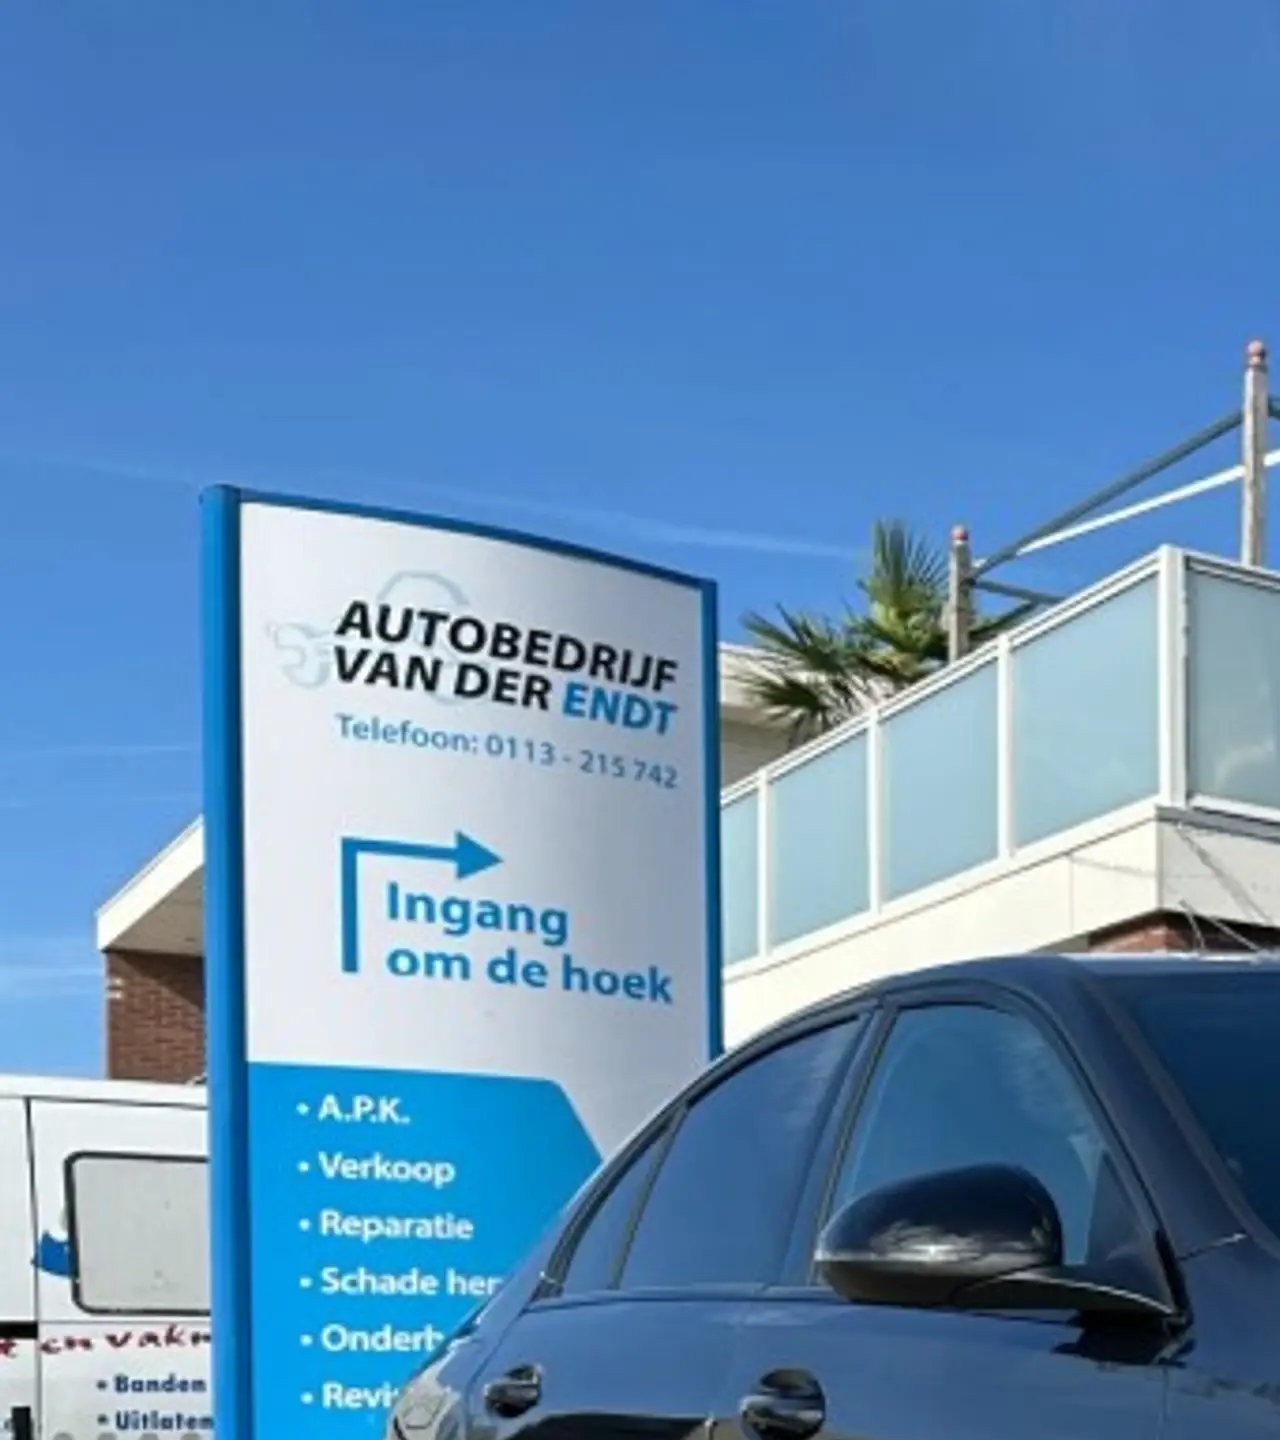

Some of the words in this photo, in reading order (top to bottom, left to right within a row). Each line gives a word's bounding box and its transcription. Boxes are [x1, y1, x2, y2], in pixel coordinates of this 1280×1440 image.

[334, 600, 679, 693] AUTOBEDRIJF
[334, 645, 443, 693] VAN
[453, 663, 553, 711] DER
[562, 681, 679, 736] ENDT
[334, 713, 479, 755] Telefoon:
[485, 733, 555, 766] 0113
[580, 750, 626, 780] 215
[634, 758, 679, 789] 742
[386, 881, 569, 947] Ingang
[386, 948, 470, 983] om
[486, 948, 549, 988] de
[562, 955, 673, 1003] hoek
[318, 1093, 411, 1125] A.P.K.
[318, 1151, 457, 1189] Verkoop
[319, 1208, 475, 1244] Reparatie
[321, 1266, 440, 1296] Schade
[114, 1372, 207, 1393] Banden
